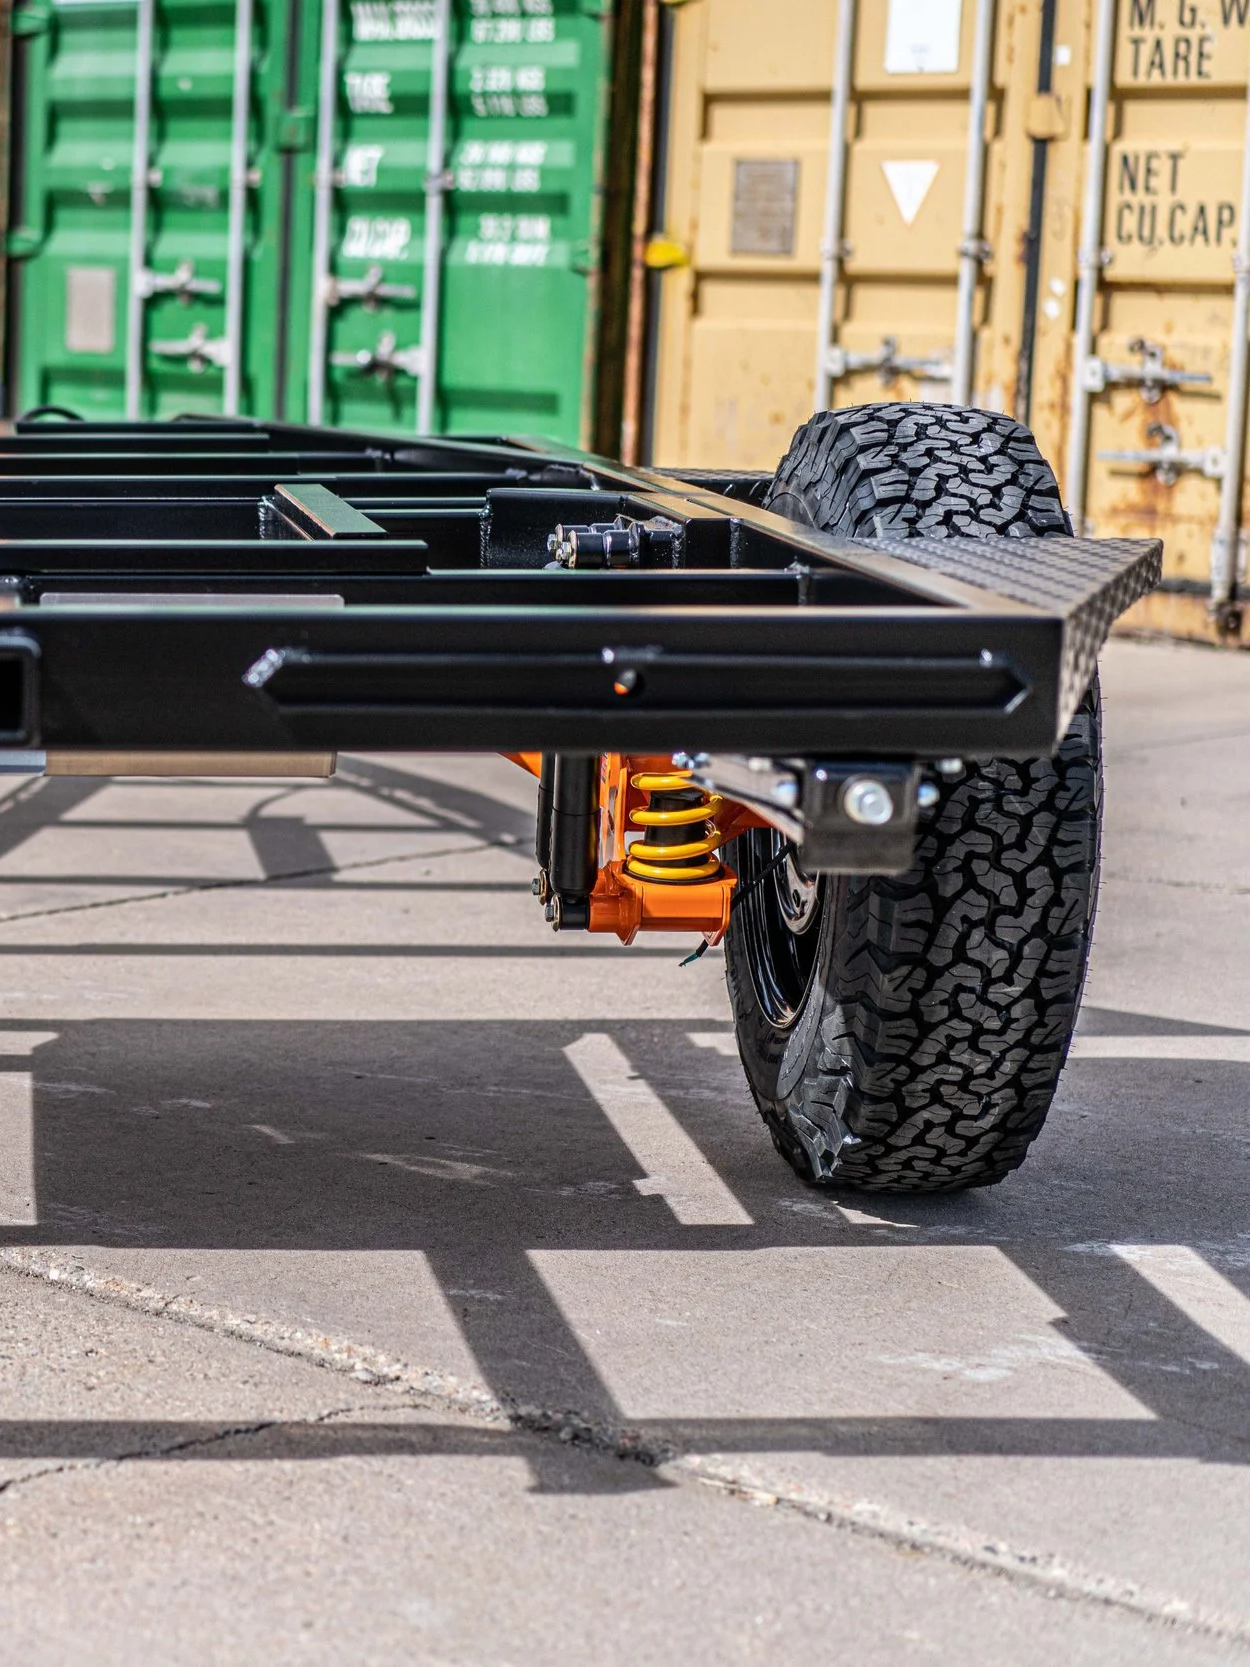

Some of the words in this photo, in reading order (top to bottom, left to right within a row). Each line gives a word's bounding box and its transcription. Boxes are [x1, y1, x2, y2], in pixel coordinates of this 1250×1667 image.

[1128, 35, 1213, 80] TARE
[1117, 151, 1185, 197] NET
[1115, 201, 1238, 249] CU.CAP.
